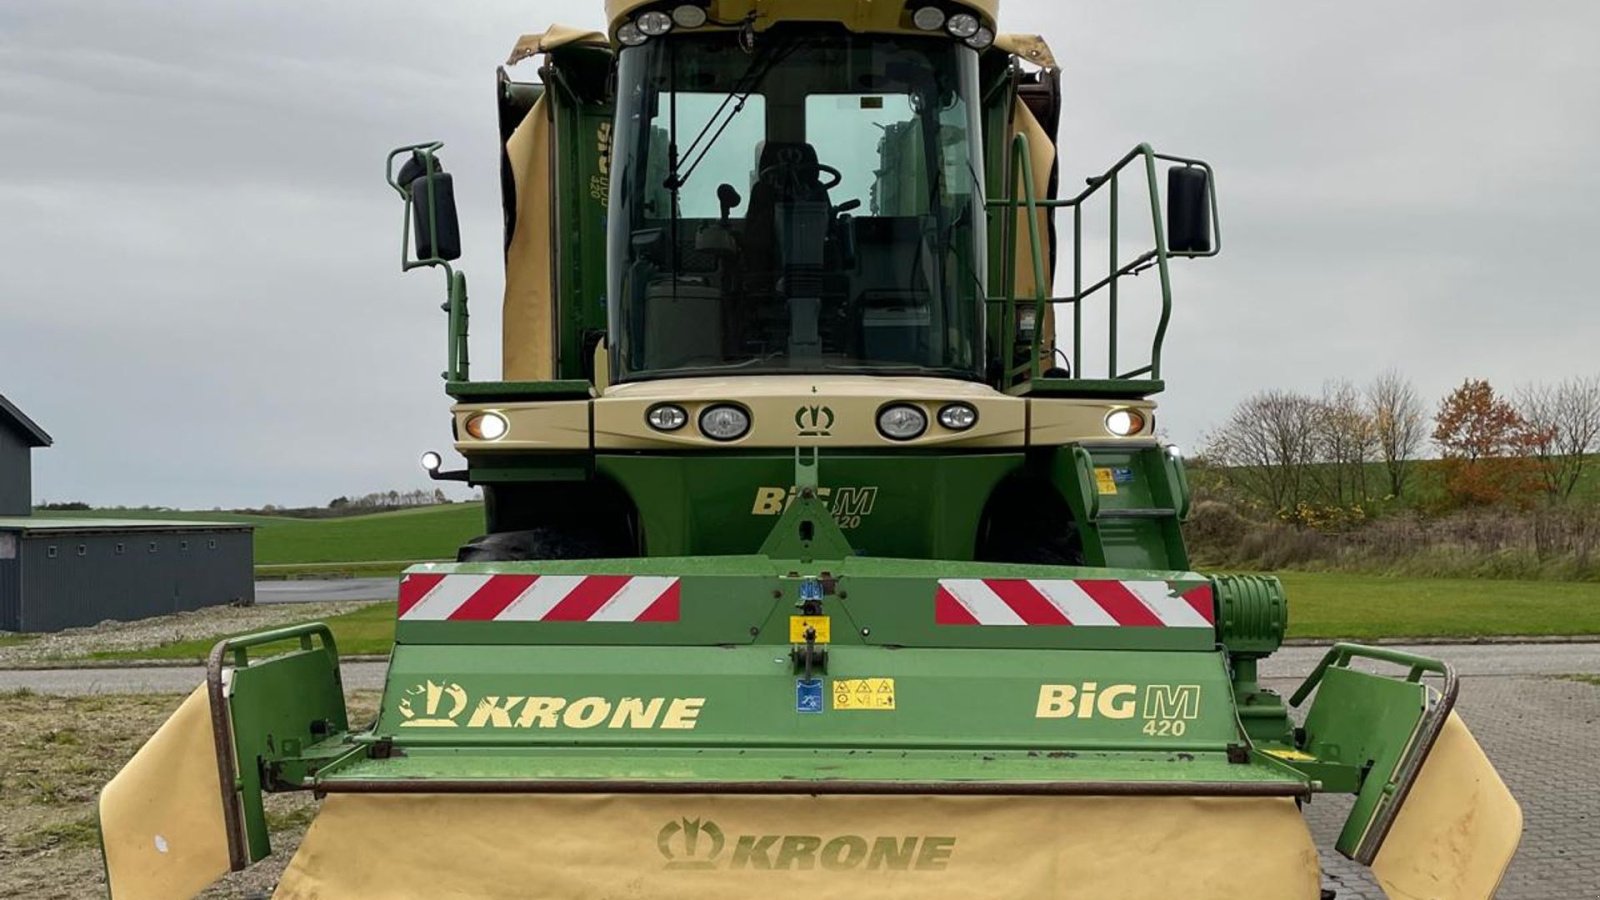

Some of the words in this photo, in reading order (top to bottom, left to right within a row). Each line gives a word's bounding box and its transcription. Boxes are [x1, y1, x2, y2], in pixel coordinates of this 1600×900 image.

[836, 515, 860, 528] 20
[467, 696, 706, 729] KRONE
[1143, 685, 1201, 719] M
[1143, 720, 1186, 736] 420
[729, 835, 957, 871] KRONE
